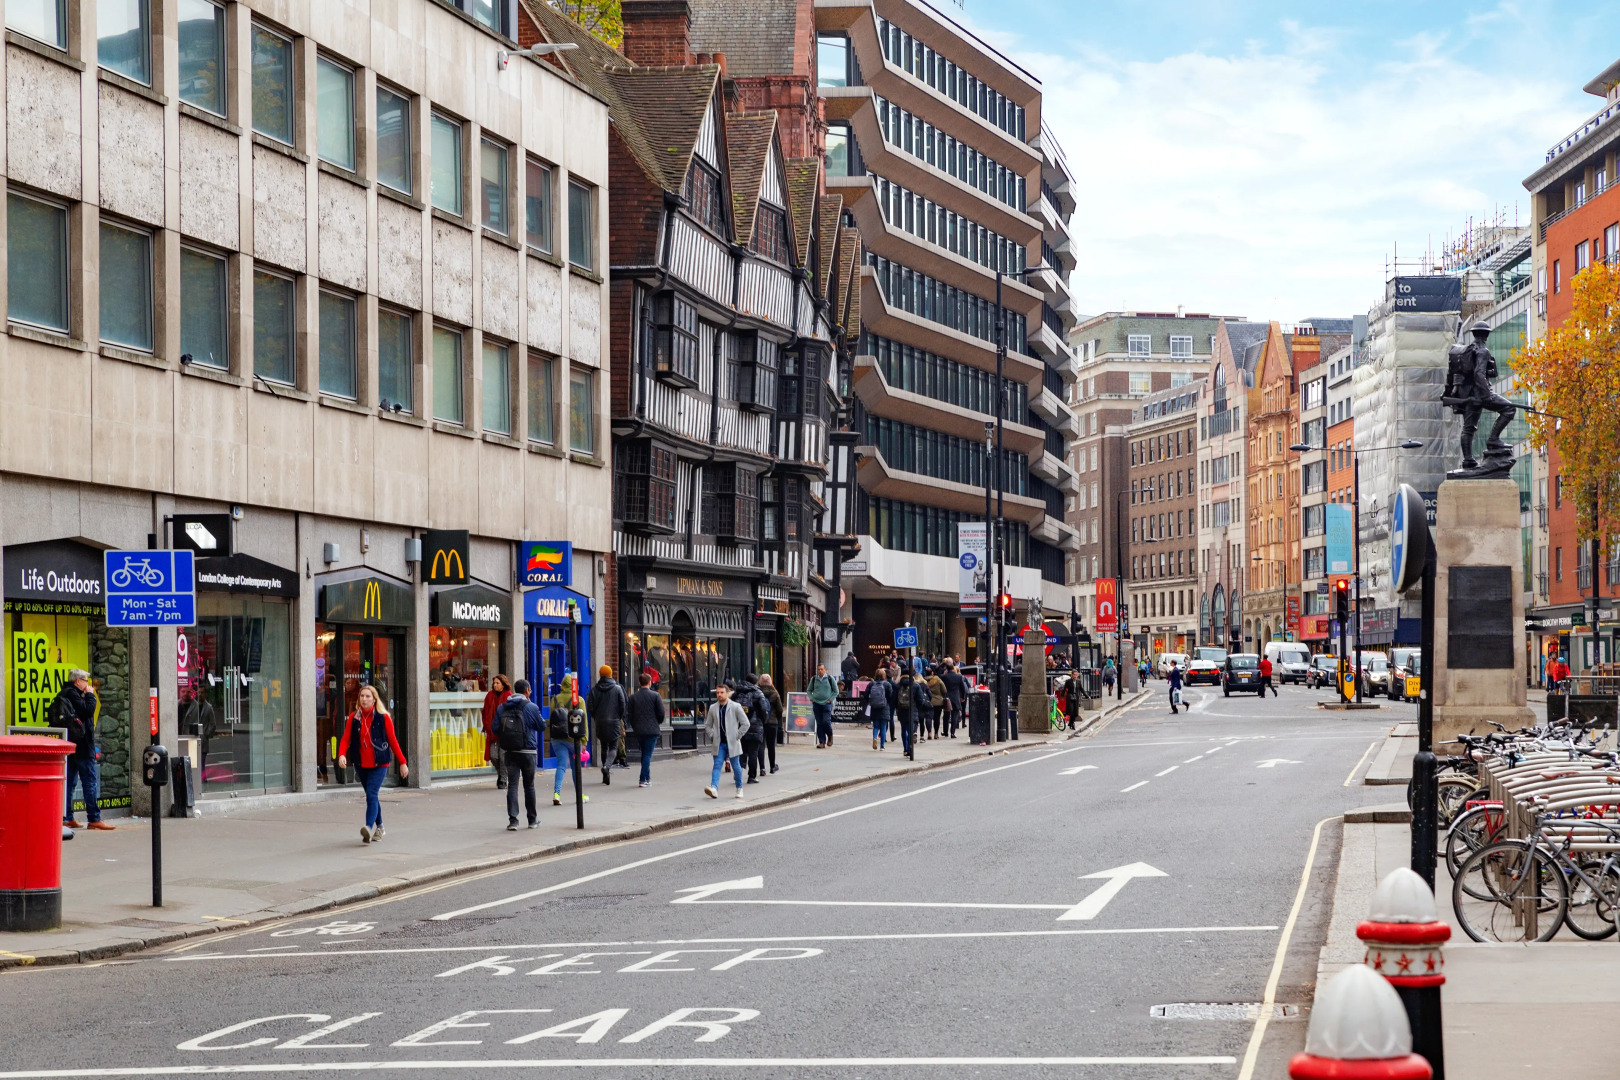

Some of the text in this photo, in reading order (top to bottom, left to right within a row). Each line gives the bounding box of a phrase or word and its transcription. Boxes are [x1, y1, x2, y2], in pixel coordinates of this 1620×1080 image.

[1398, 284, 1412, 293] to
[22, 568, 100, 594] Life Outdoors
[199, 572, 281, 589] London College of Contemporary Arts
[527, 573, 564, 582] CORAL
[677, 578, 723, 596] LIPMAN & SONS
[14, 602, 22, 611] UP
[23, 603, 31, 611] TO
[32, 603, 43, 612] 60%
[44, 603, 54, 612] OFF
[55, 604, 62, 613] UP
[63, 604, 71, 613] TO
[72, 605, 82, 614] 60%
[82, 606, 92, 614] OFF
[93, 607, 100, 615] UP
[122, 598, 146, 608] Mon
[157, 598, 176, 608] Sat
[537, 598, 566, 616] CORAL
[156, 610, 181, 621] 7pm
[452, 602, 500, 622] McDonald's
[1542, 618, 1558, 627] DOROTHY
[1559, 617, 1572, 626] PERKIN
[18, 638, 46, 664] BIG
[18, 668, 66, 693] BRAN
[18, 698, 50, 722] EVE
[73, 801, 84, 810] 60%
[104, 799, 110, 807] TO
[111, 798, 121, 806] 60%
[435, 948, 824, 978] KEEP
[176, 1008, 761, 1052] CLEAR
